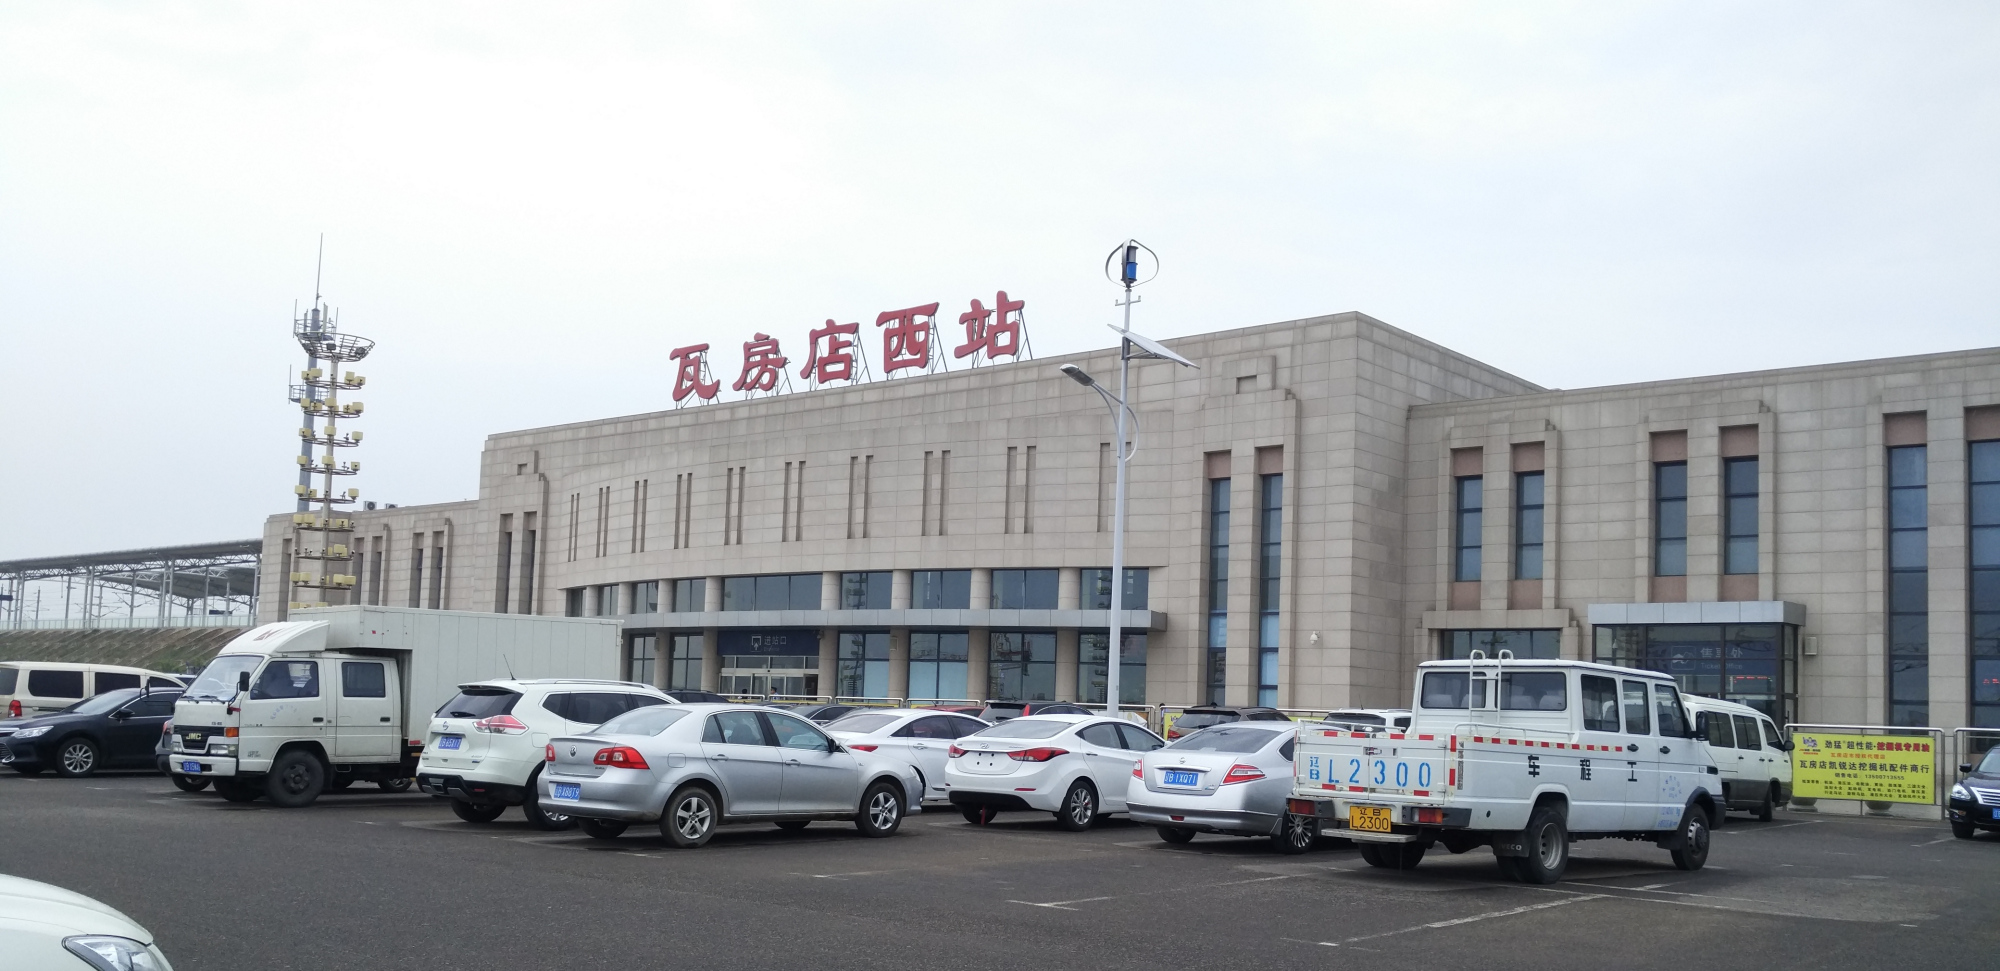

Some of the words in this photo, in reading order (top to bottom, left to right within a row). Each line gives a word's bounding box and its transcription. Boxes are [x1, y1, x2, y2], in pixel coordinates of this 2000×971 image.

[669, 290, 1025, 402] 瓦房店西站
[764, 635, 787, 646] 进站口
[1328, 758, 1431, 787] L2300
[1351, 815, 1389, 830] L2300
